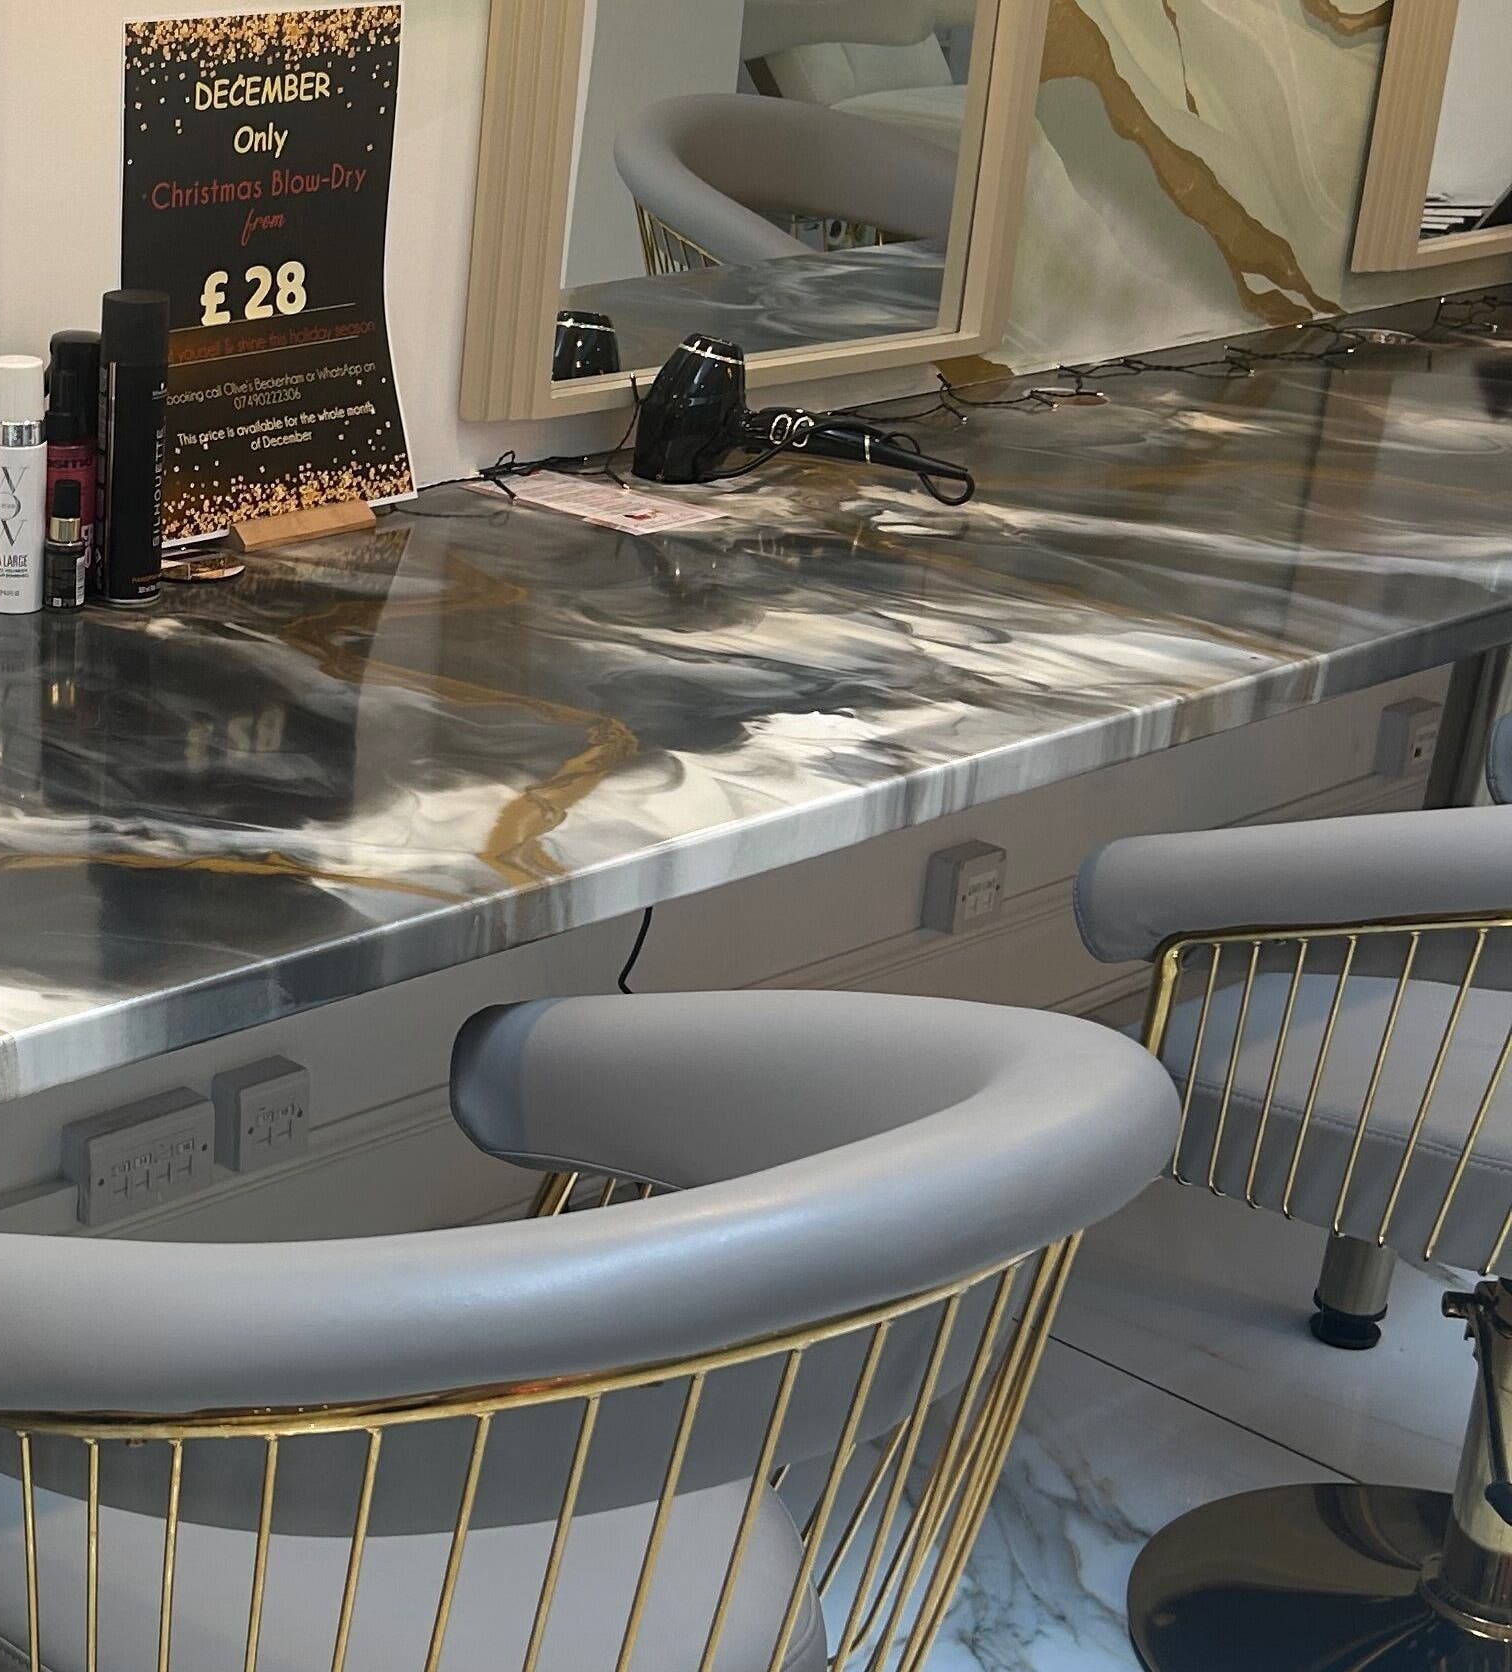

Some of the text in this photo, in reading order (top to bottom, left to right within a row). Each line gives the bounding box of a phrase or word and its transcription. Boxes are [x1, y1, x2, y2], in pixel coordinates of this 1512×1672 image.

[194, 71, 331, 111] DECEMBER
[233, 121, 289, 158] Only
[151, 162, 367, 210] Christmas Blow-Dry
[240, 207, 286, 247] from
[200, 260, 307, 326] £ 28
[205, 383, 222, 399] call
[305, 370, 316, 383] or
[316, 362, 363, 382] WhatsApp
[233, 387, 302, 411] 07490222306
[177, 431, 197, 448] This
[198, 426, 225, 447] price
[226, 424, 236, 439] is
[236, 415, 284, 438] available
[284, 412, 299, 430] for
[299, 408, 318, 426] the
[317, 405, 346, 422] whole
[250, 428, 313, 451] of December
